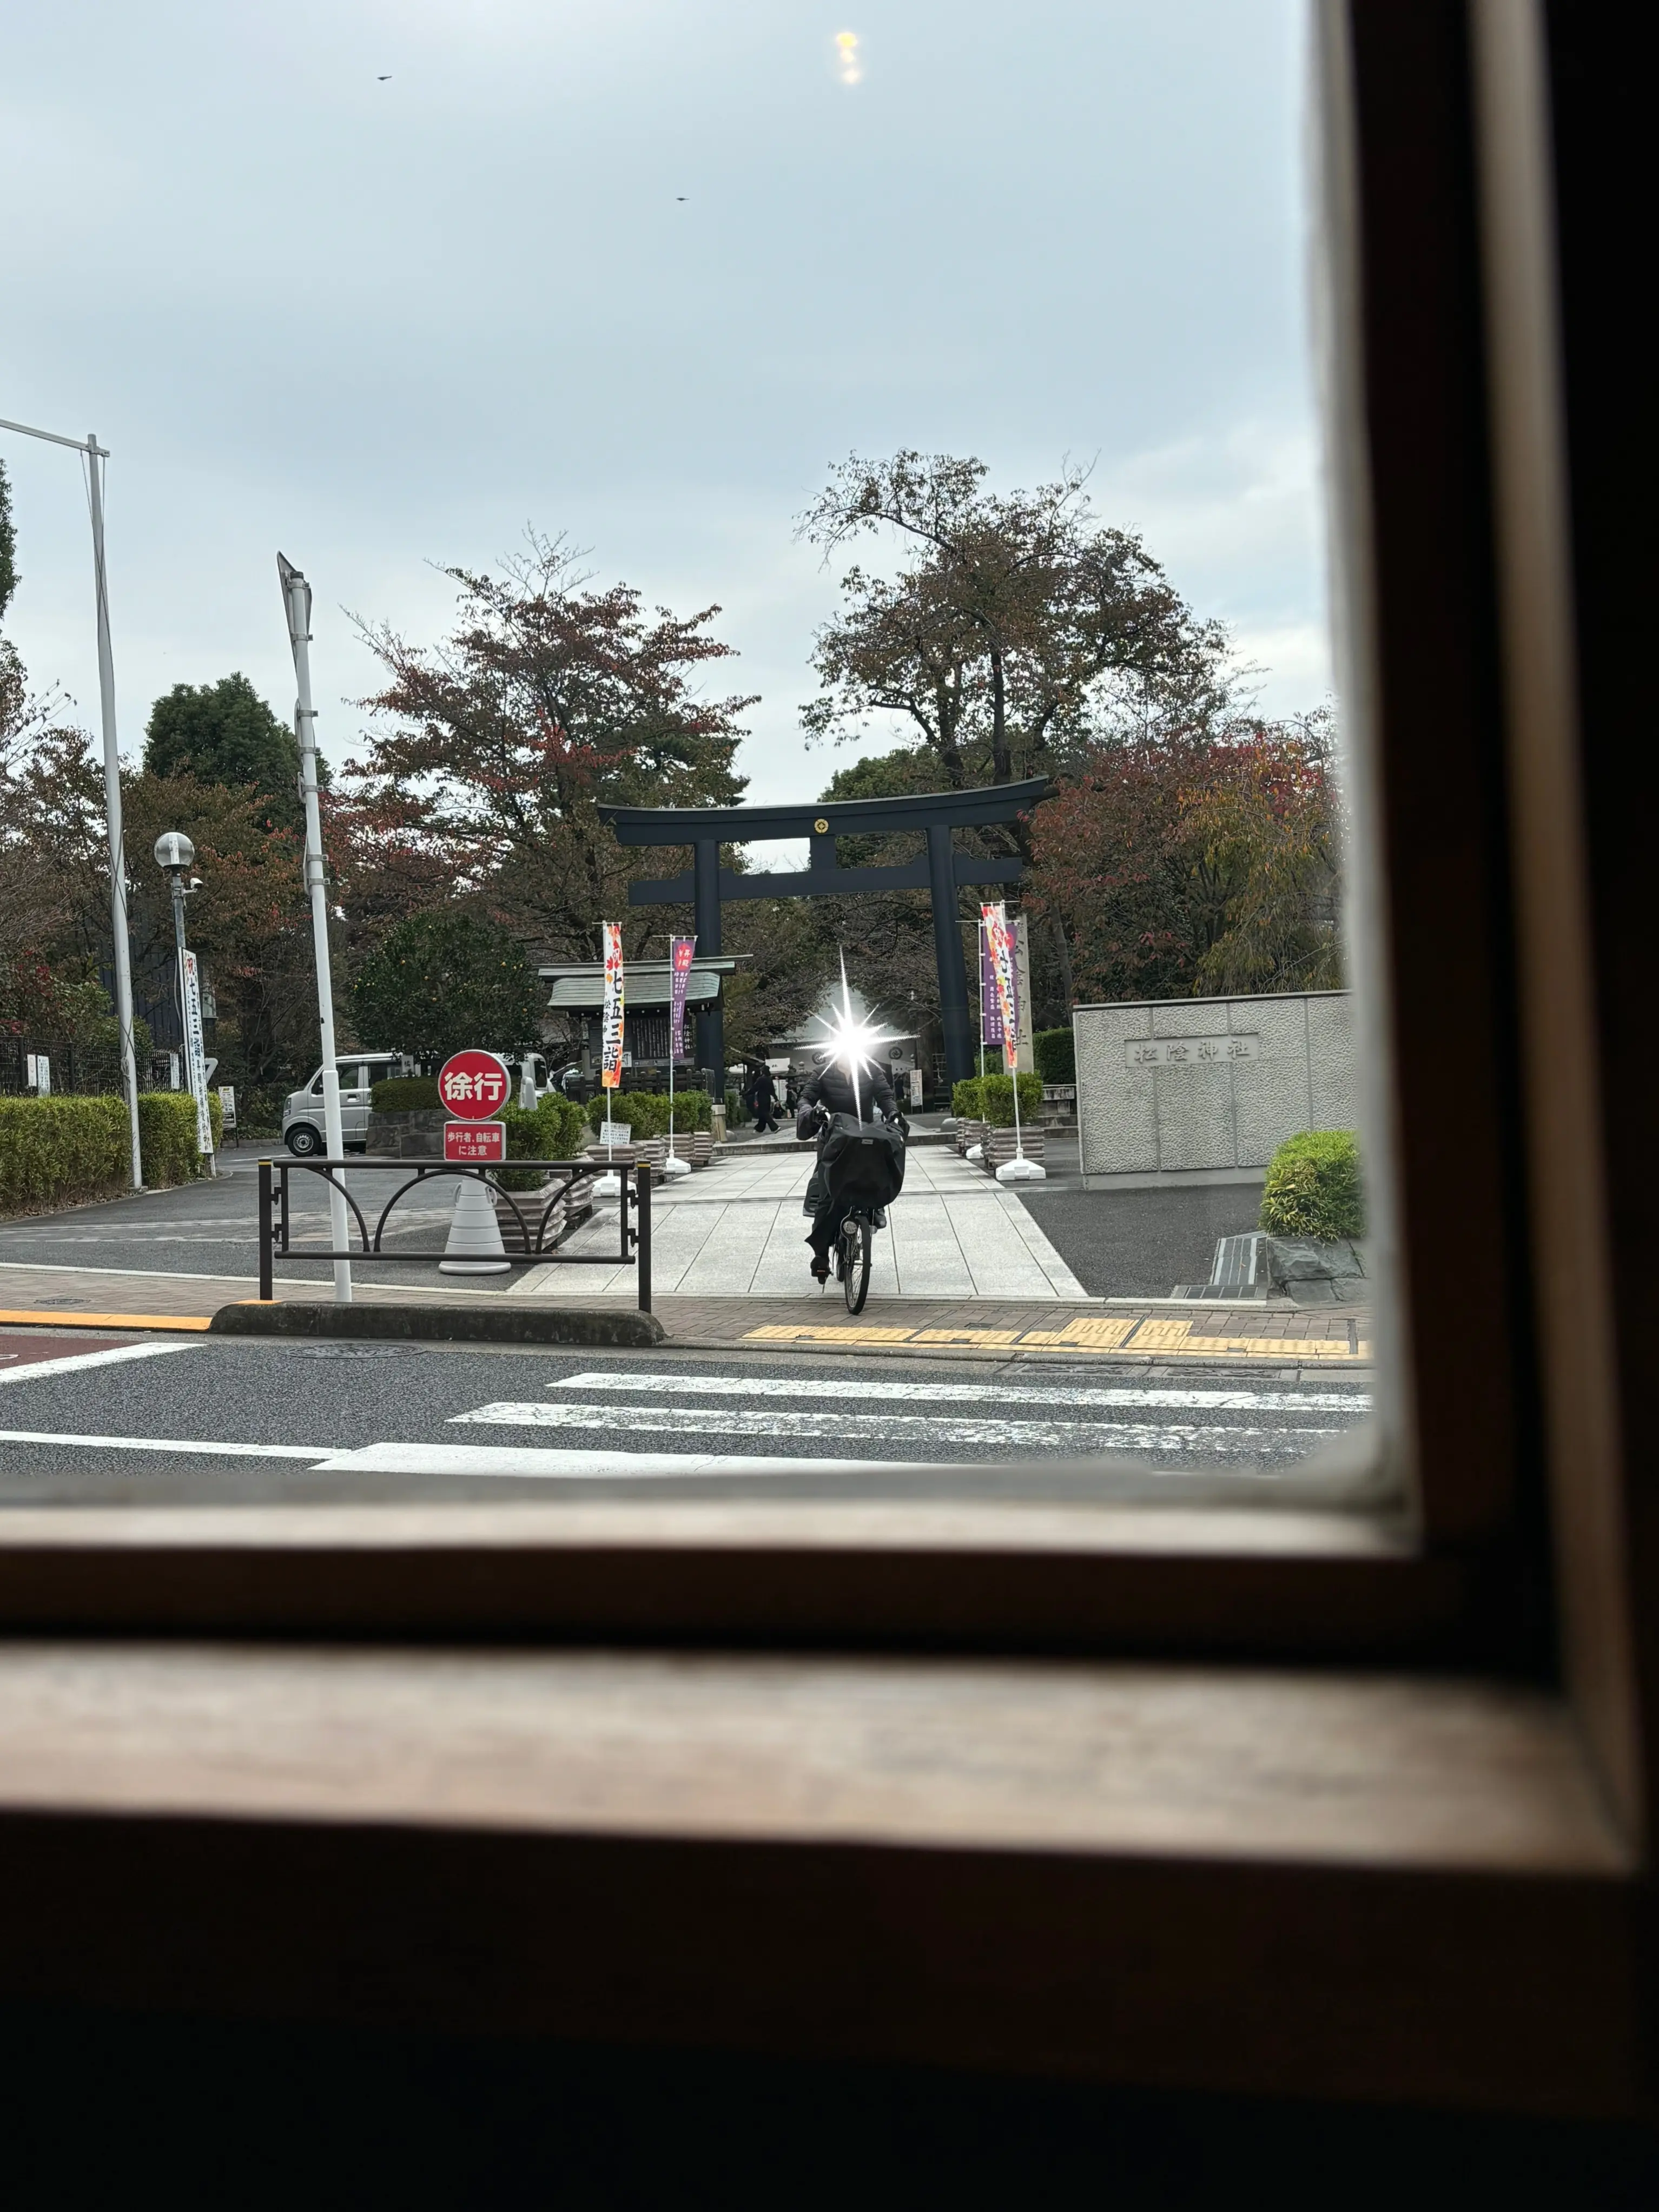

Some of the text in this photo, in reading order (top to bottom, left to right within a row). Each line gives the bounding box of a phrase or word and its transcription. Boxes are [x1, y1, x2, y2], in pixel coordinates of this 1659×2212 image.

[1134, 1038, 1250, 1064] 松陰神社
[444, 1072, 503, 1100] 徐行
[448, 1132, 500, 1143] 歩行者、自転車
[459, 1145, 487, 1155] に注意
